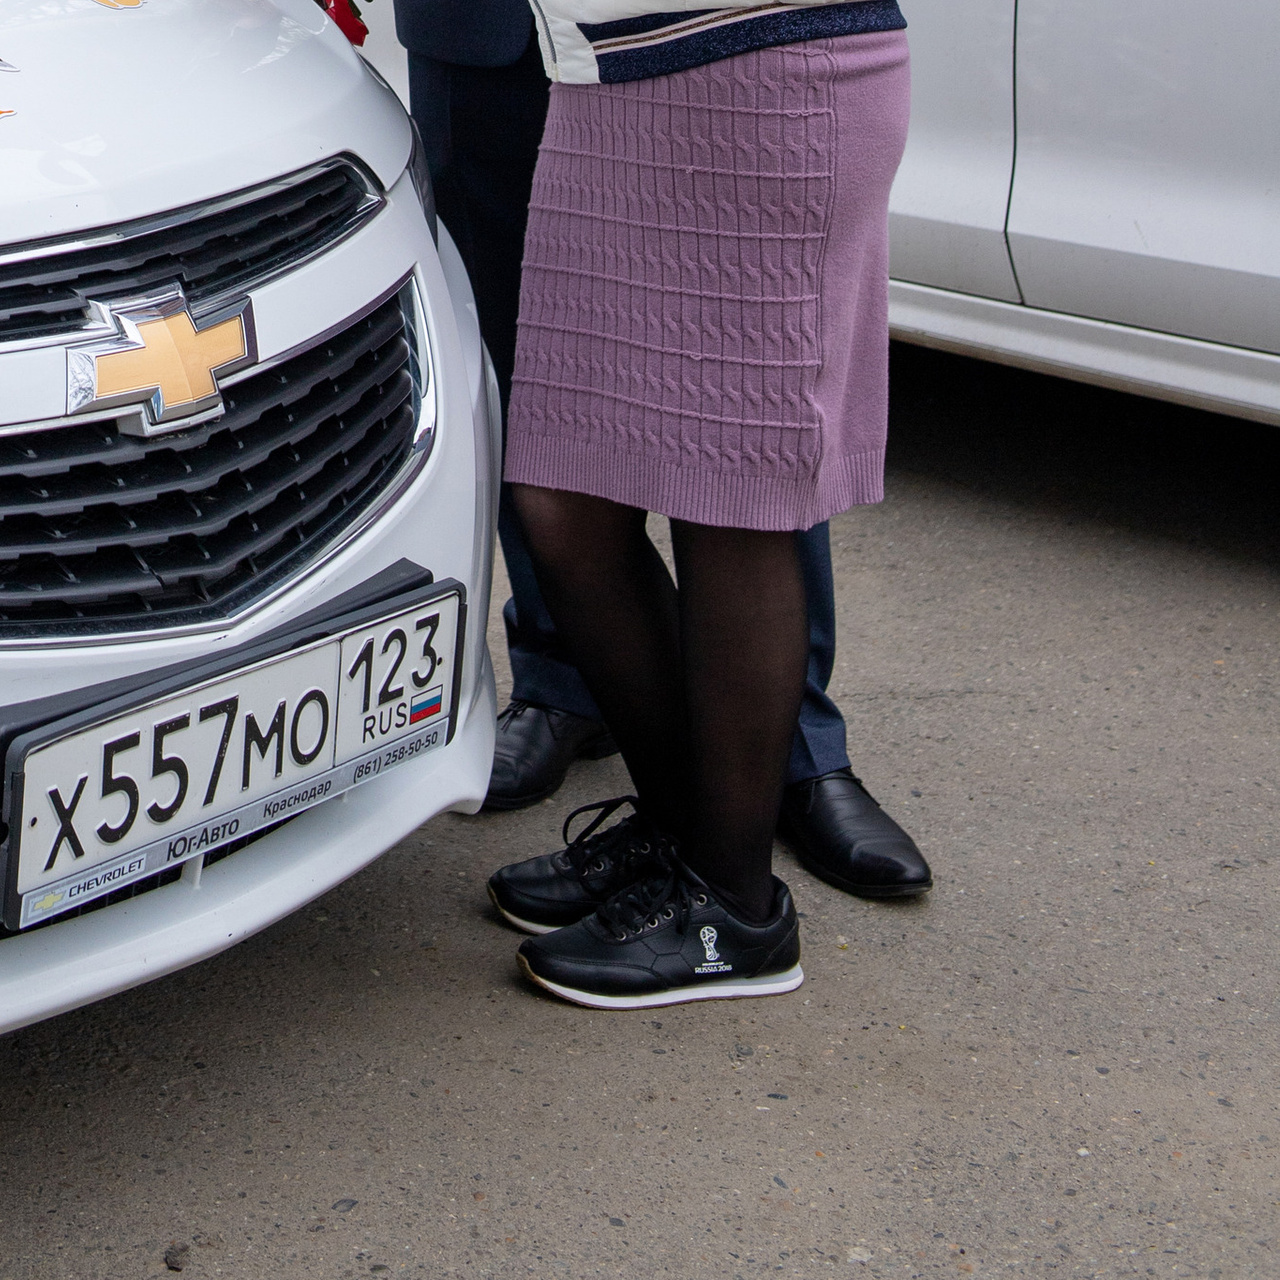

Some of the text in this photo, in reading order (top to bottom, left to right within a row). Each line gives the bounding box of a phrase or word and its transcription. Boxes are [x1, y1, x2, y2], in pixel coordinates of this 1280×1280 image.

[347, 611, 440, 714] 123
[362, 702, 408, 744] RUS
[353, 731, 438, 784] (861) 258-50-50
[263, 779, 332, 819] Краснодар
[68, 857, 145, 898] CHEVROLET
